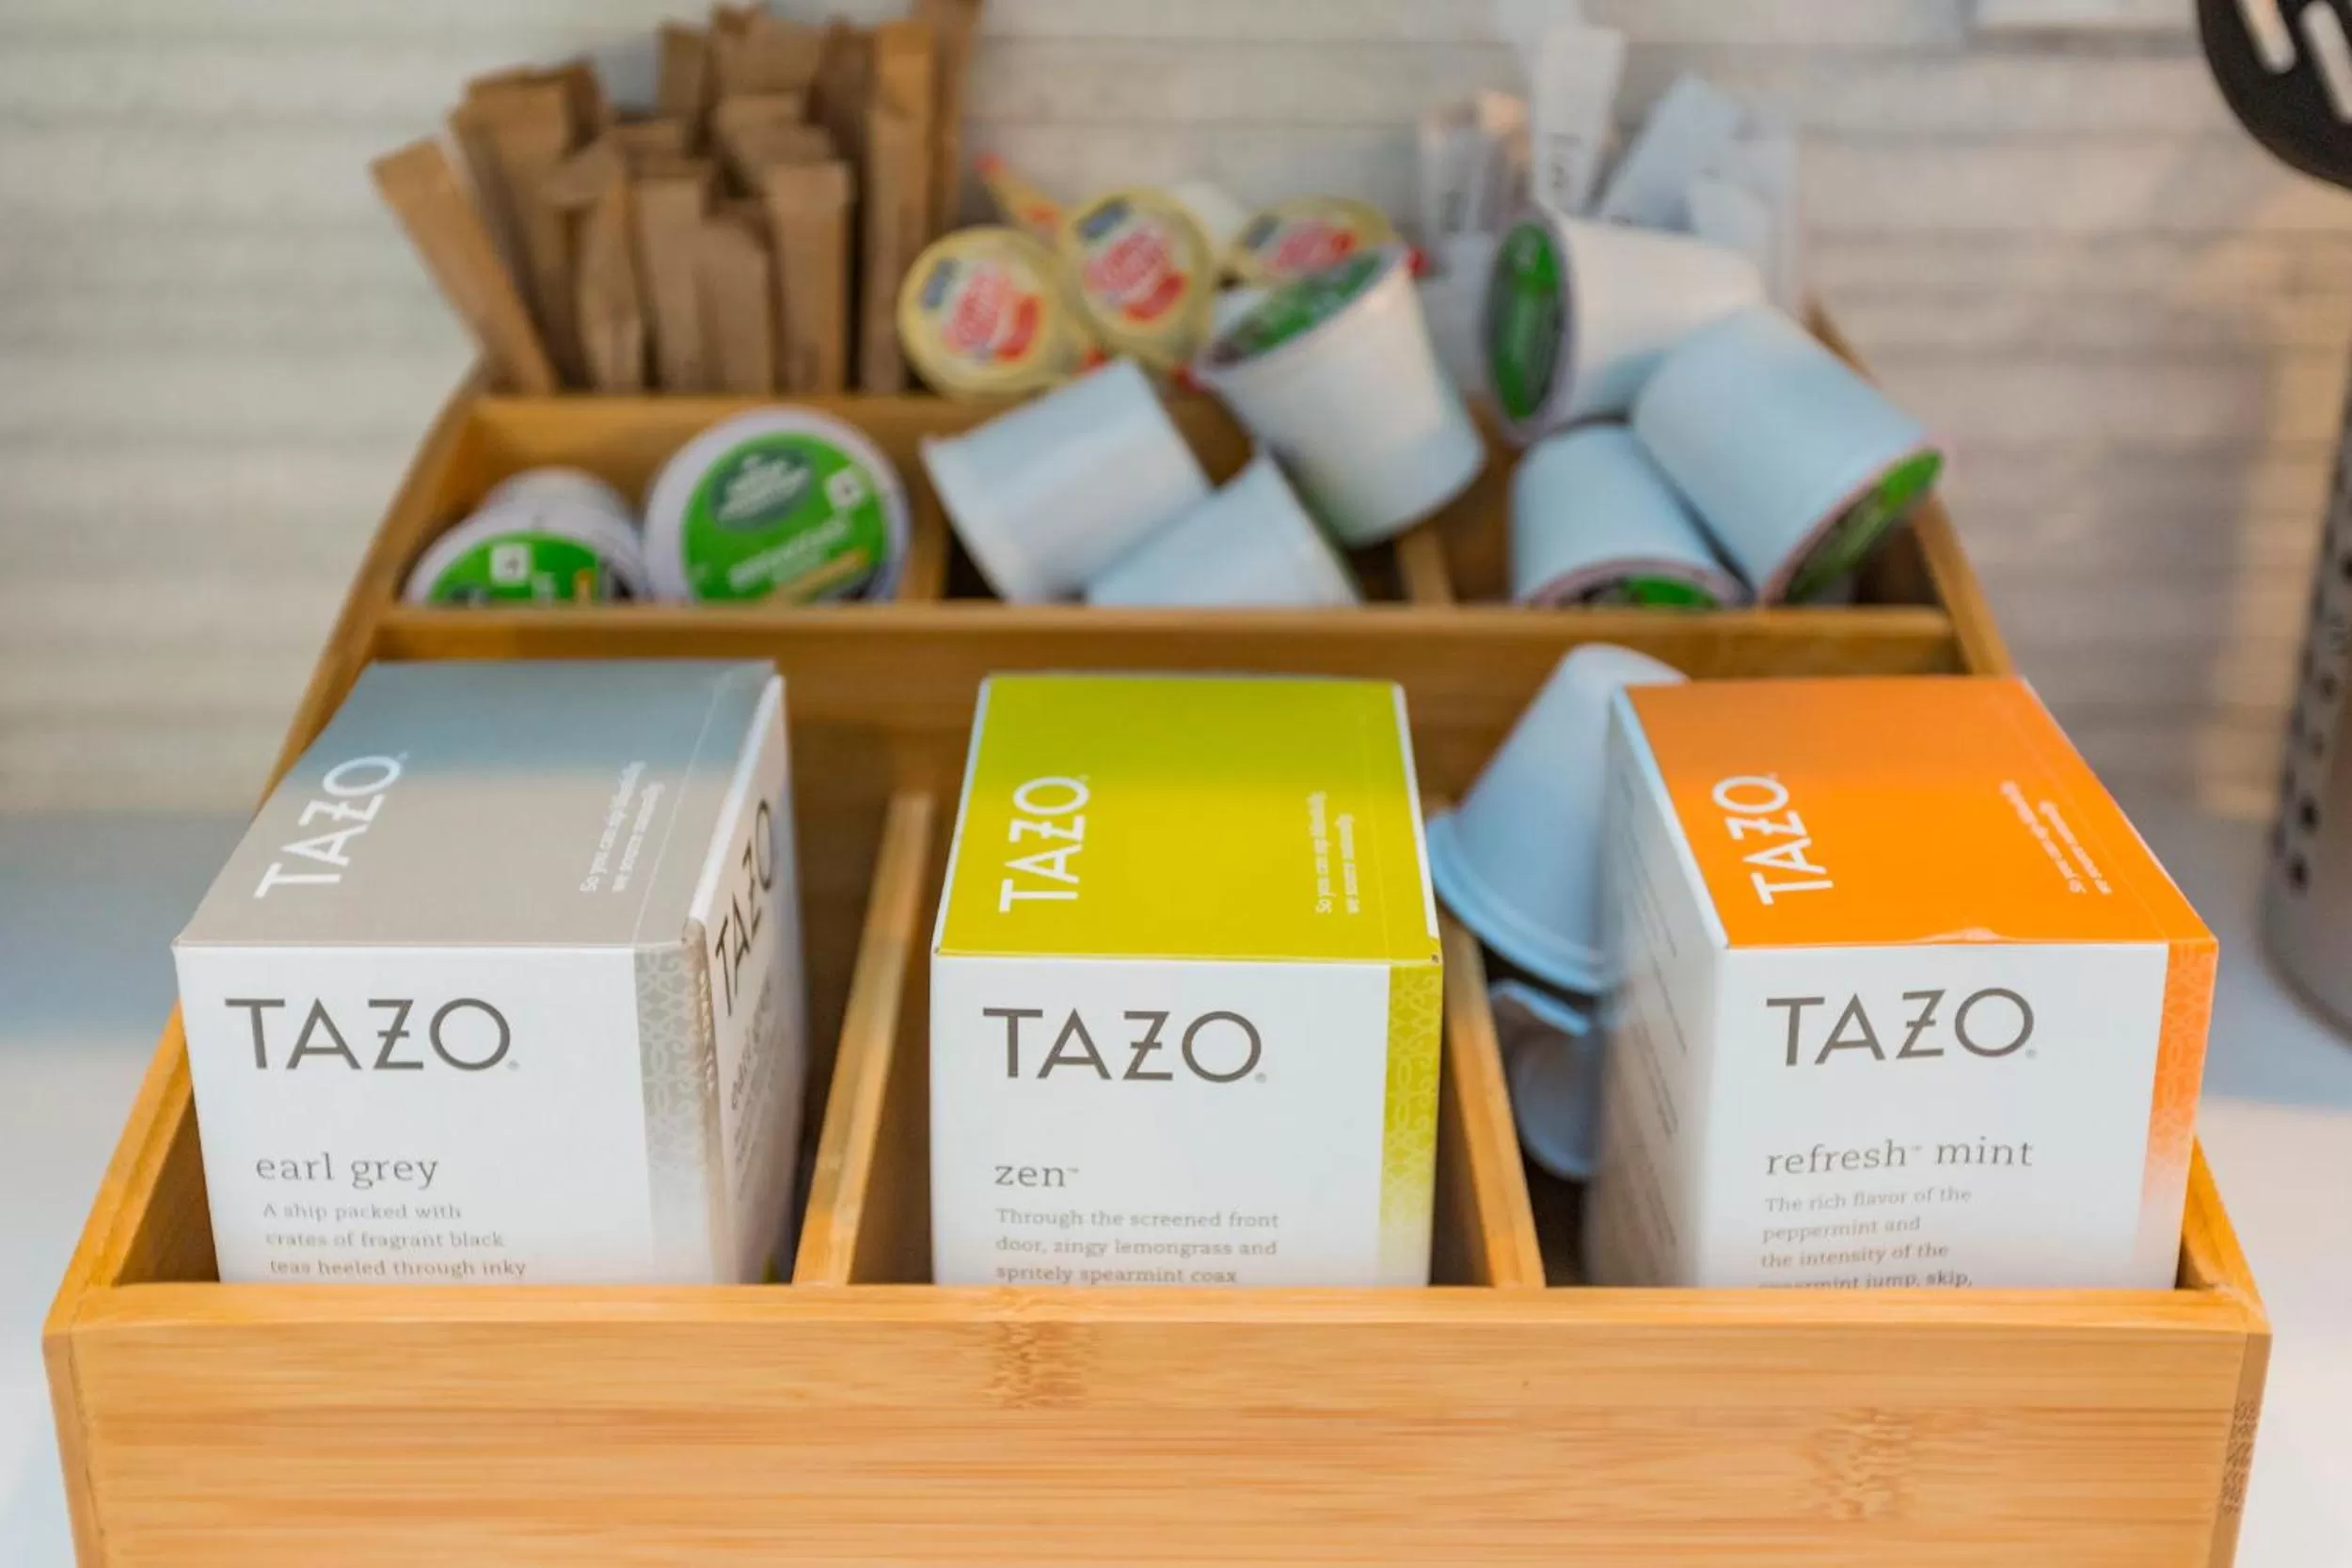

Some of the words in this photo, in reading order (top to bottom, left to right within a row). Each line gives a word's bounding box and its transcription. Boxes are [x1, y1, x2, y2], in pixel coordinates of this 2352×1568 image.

[253, 755, 402, 898] TAZO
[999, 776, 1090, 912] TAZO
[1712, 776, 1834, 906] TAZO
[225, 998, 511, 1070] TAZO
[1766, 987, 2035, 1067] TAZO
[983, 1007, 1263, 1084] TAZO
[1936, 1135, 2034, 1166] mint
[256, 1151, 335, 1181] earl
[351, 1159, 438, 1190] grey
[263, 1204, 277, 1218] A
[284, 1203, 327, 1222] ship
[335, 1202, 407, 1221] packed
[414, 1203, 462, 1219] with
[1765, 1196, 1803, 1213] The
[1809, 1192, 1847, 1212] rich
[1853, 1190, 1908, 1207] flavor
[1914, 1186, 1935, 1204] of
[1940, 1184, 1973, 1204] the
[995, 1207, 1084, 1229] Through
[1090, 1210, 1125, 1227] the
[1130, 1210, 1222, 1228] screened
[1229, 1212, 1280, 1229] front
[1762, 1218, 1879, 1243] peppermint
[1884, 1215, 1922, 1232] and
[266, 1231, 327, 1246] crates
[334, 1231, 354, 1246] of
[361, 1231, 444, 1250] fragrant
[452, 1231, 506, 1247] black
[995, 1236, 1048, 1254] door,
[1115, 1238, 1233, 1259] lemongrass
[1239, 1241, 1278, 1257] and
[271, 1259, 311, 1275] teas
[318, 1259, 387, 1276] heeled
[393, 1259, 476, 1279] through
[482, 1259, 528, 1278] inky
[1760, 1253, 1793, 1269] the
[1799, 1247, 1887, 1267] intensity
[1892, 1243, 1914, 1259] of
[1917, 1241, 1949, 1259] the
[996, 1265, 1075, 1285] spritely
[1082, 1266, 1184, 1285] spearmint
[1190, 1268, 1238, 1284] coax
[1866, 1273, 1921, 1290] jump,
[1926, 1269, 1974, 1288] skip,
